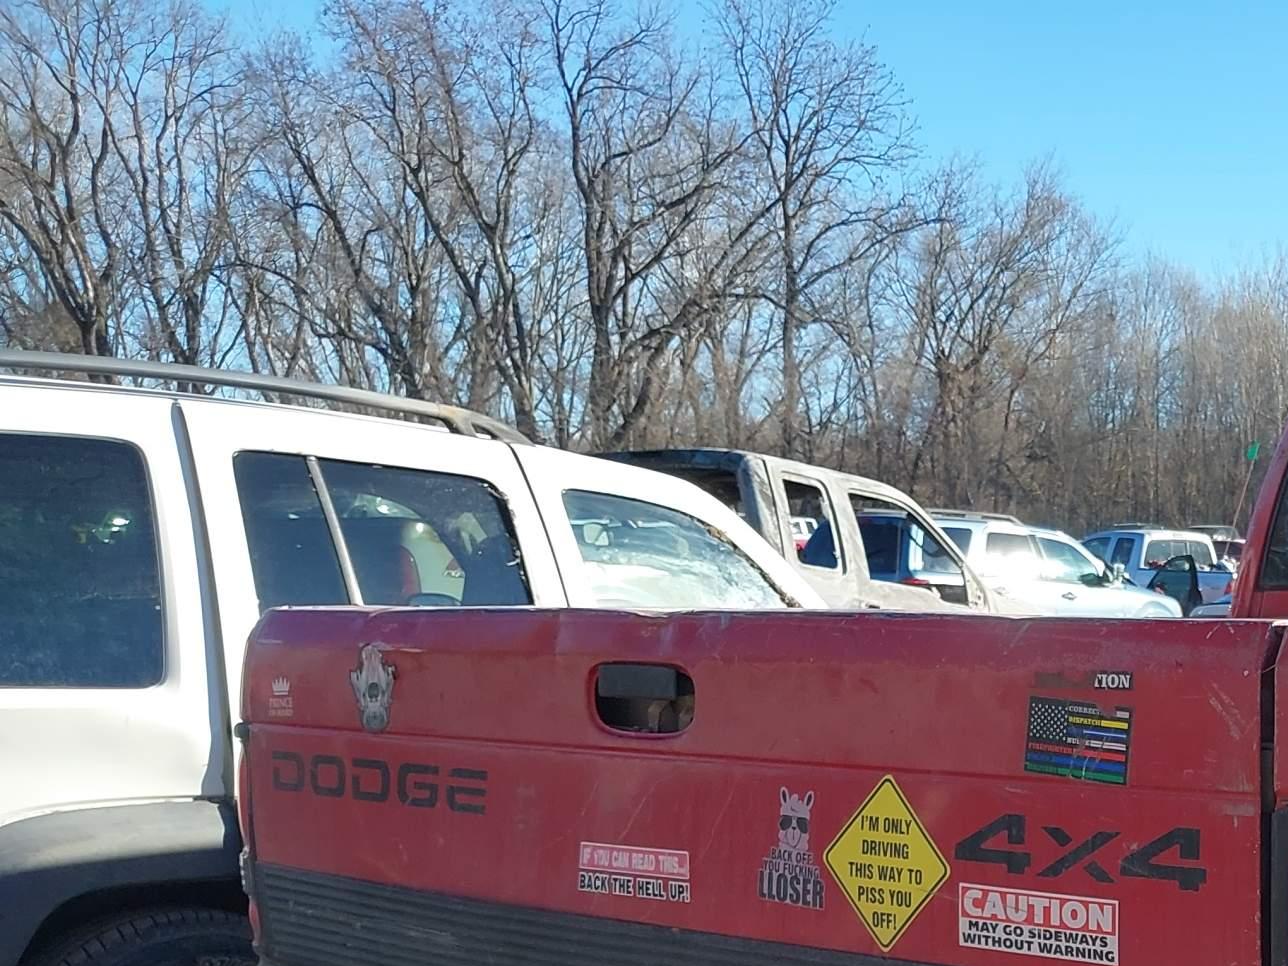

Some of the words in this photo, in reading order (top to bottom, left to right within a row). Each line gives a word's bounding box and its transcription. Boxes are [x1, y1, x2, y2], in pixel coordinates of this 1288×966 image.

[272, 750, 488, 816] DODGE
[861, 815, 879, 833] I'M
[883, 817, 912, 836] ONLY
[771, 848, 793, 862] BACK
[795, 851, 813, 865] OFF
[861, 839, 910, 860] DRIVING
[631, 852, 656, 872] READ
[763, 859, 781, 873] YOU
[783, 861, 820, 879] FUCKING
[848, 861, 874, 880] THIS
[877, 865, 903, 884] WAY
[907, 868, 923, 886] TO
[579, 873, 608, 893] BACK
[612, 876, 633, 896] THE
[637, 879, 665, 899] HELL
[669, 882, 690, 902] UP!
[759, 870, 824, 909] LLOSER
[857, 886, 885, 905] PISS
[889, 888, 912, 908] YOU
[872, 911, 897, 931] OFF!
[963, 888, 1113, 933] CAUTION
[968, 919, 999, 935] MAY
[1002, 923, 1024, 938] GO
[1028, 928, 1109, 948] SIDEWAYS
[962, 932, 1034, 952] WITHOUT
[1037, 940, 1115, 963] WARNING
